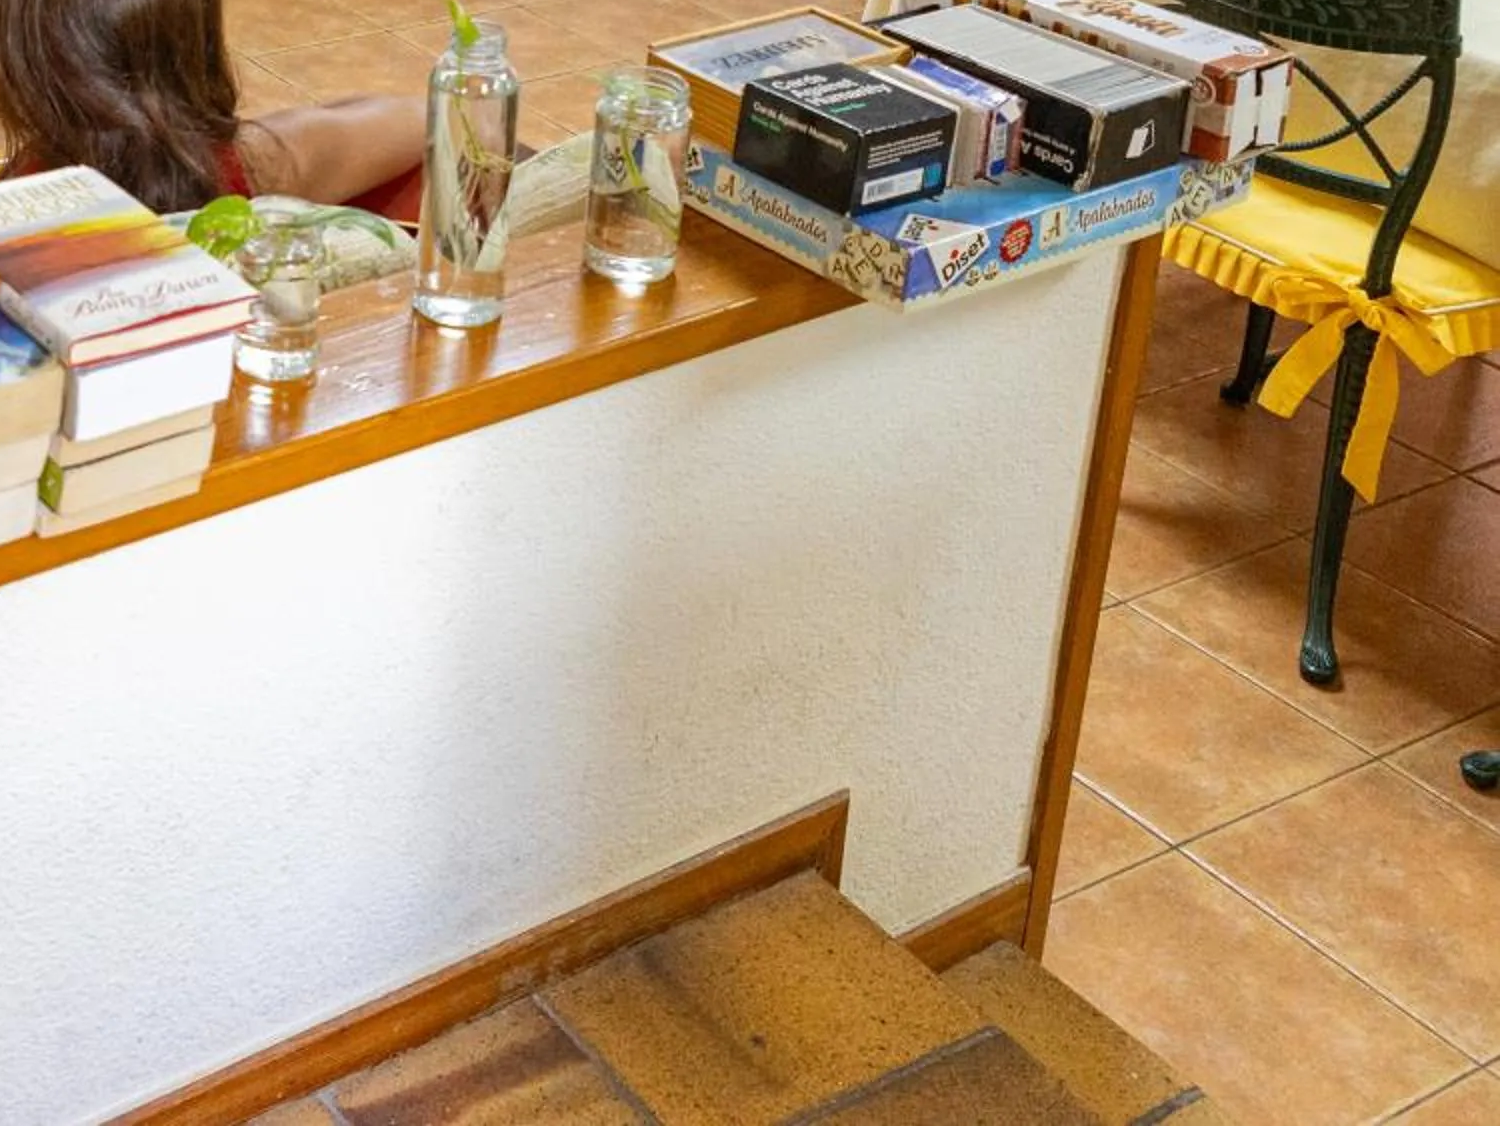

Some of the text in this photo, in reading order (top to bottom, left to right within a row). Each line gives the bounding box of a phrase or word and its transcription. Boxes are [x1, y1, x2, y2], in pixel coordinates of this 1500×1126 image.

[771, 74, 829, 91] Cards
[790, 78, 860, 100] Against
[803, 83, 894, 108] Humanity
[753, 100, 777, 119] Cards
[807, 124, 850, 154] Humanity
[1033, 145, 1075, 174] Cards
[742, 187, 828, 244] Apalabrados
[1074, 188, 1157, 230] Apalabrados
[942, 232, 987, 283] Diset
[145, 273, 221, 305] Dawn
